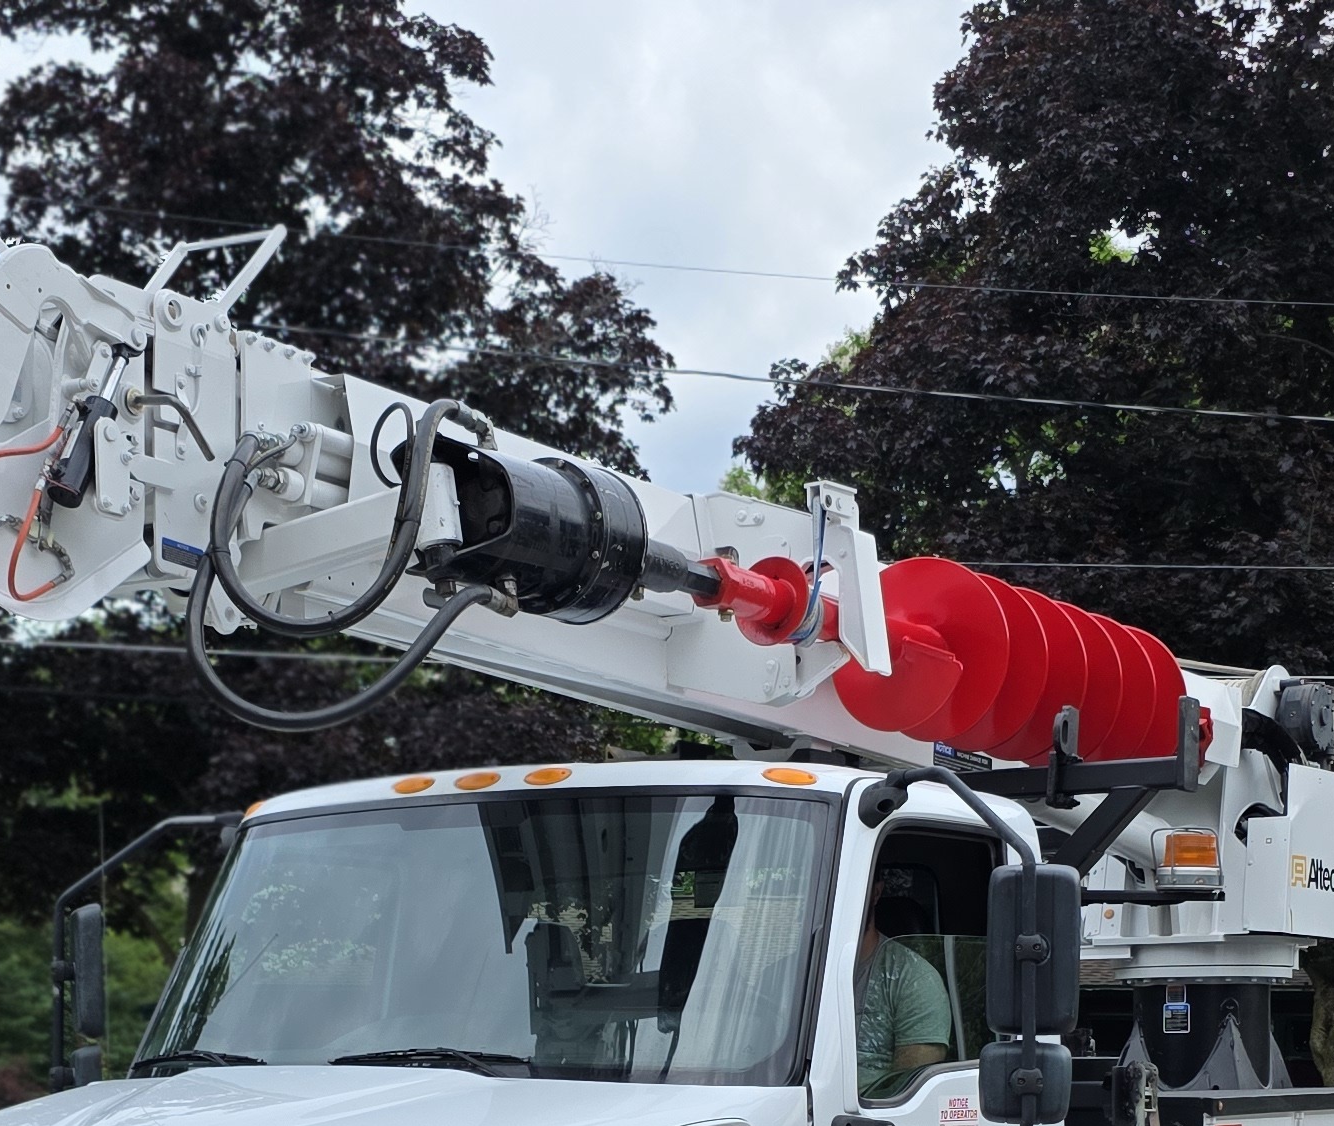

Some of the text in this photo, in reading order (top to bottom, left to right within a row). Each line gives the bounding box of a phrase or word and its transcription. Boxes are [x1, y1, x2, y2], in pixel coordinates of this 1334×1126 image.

[948, 1098, 969, 1107] NOTICE
[941, 1110, 978, 1119] TO OPERATOR
